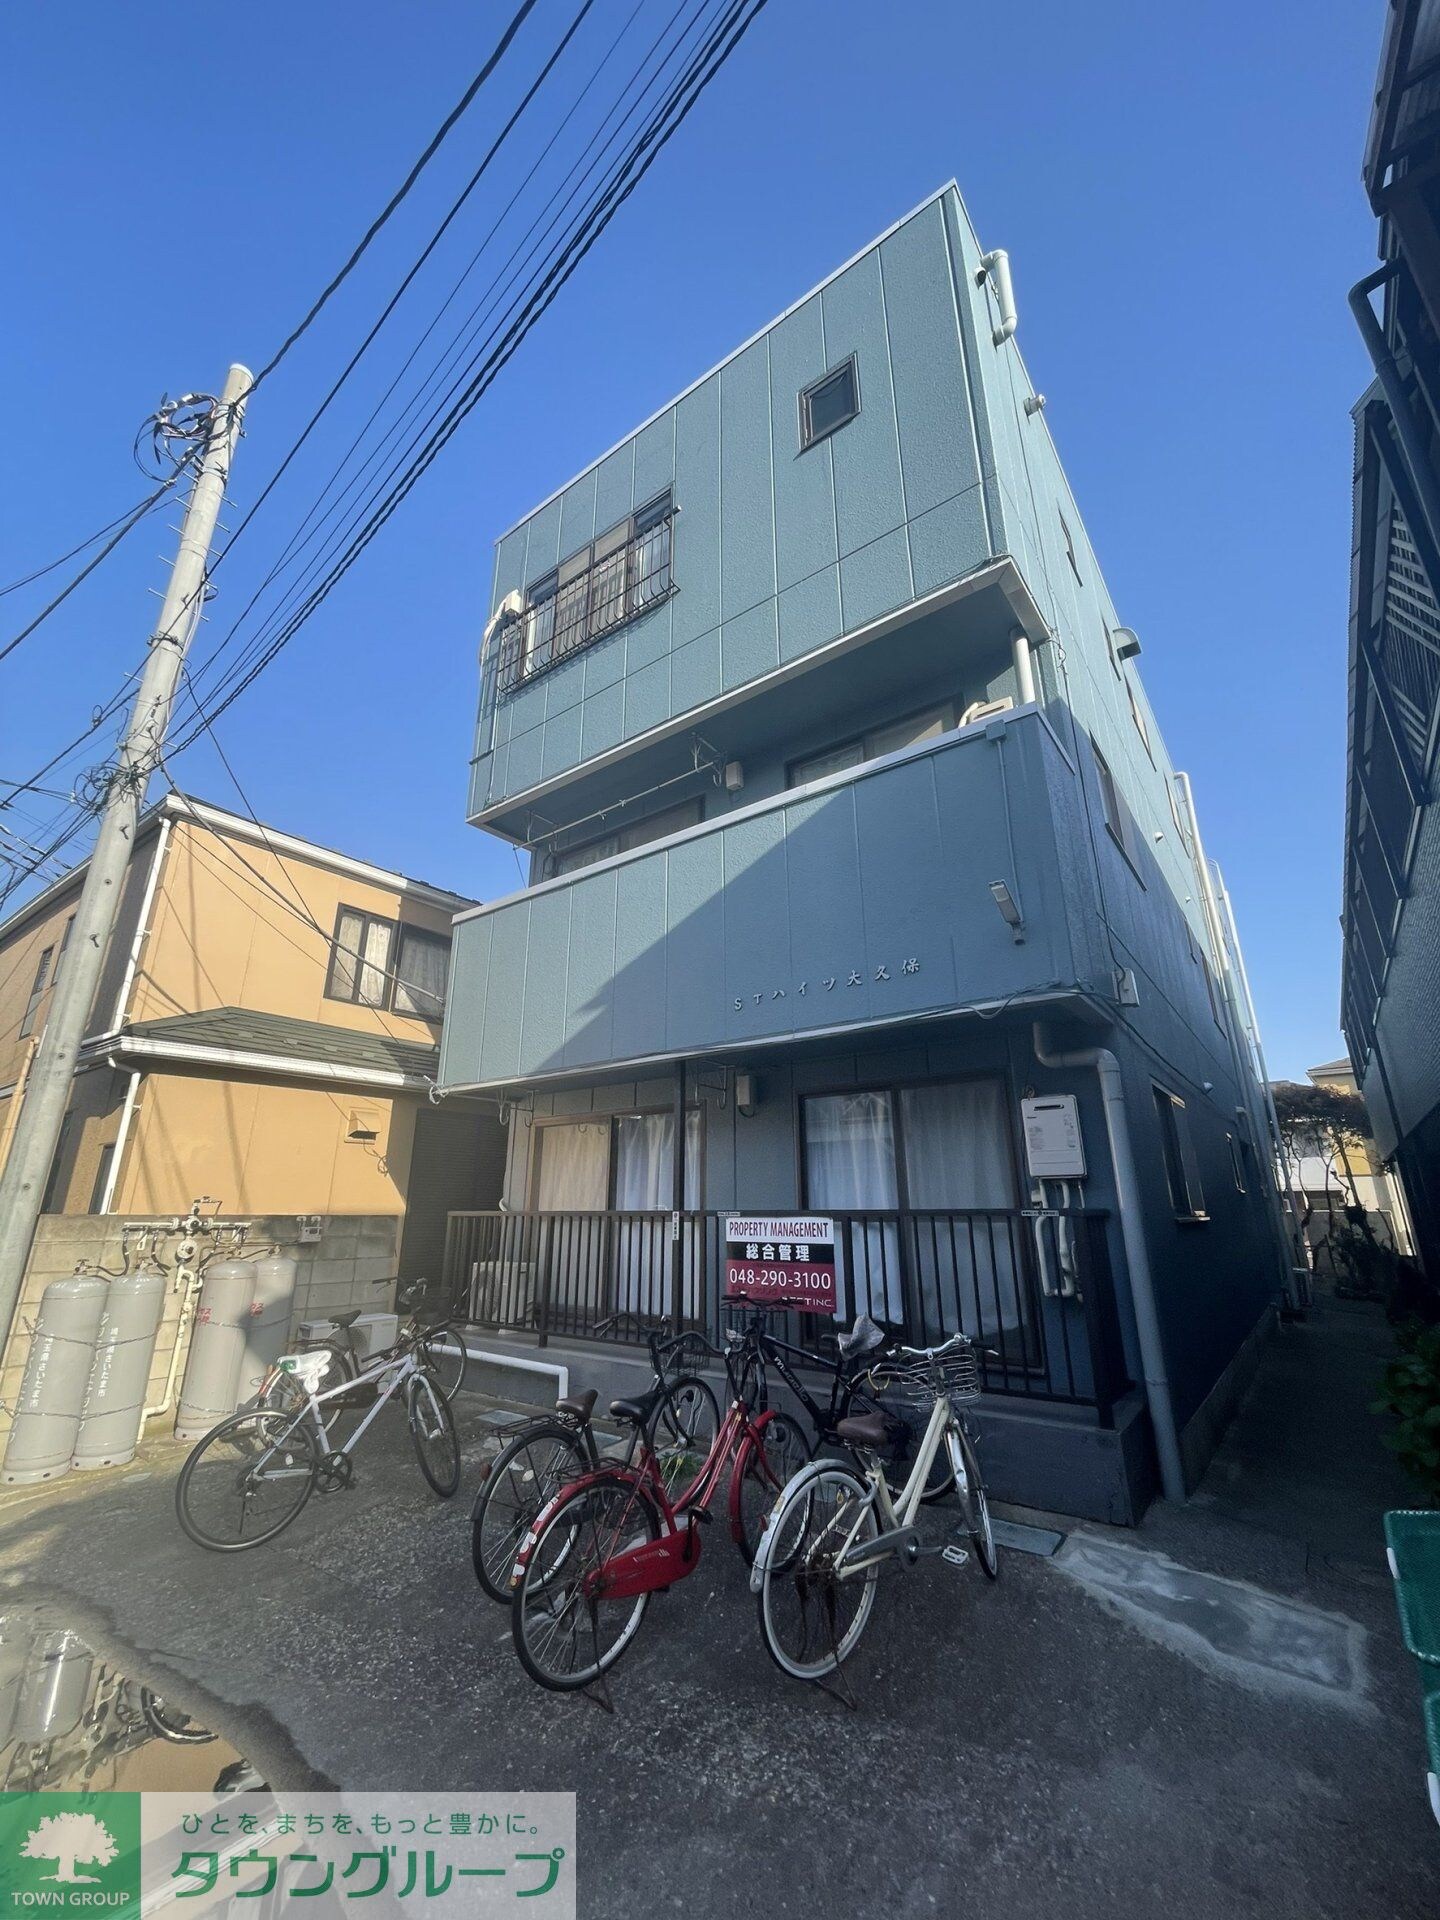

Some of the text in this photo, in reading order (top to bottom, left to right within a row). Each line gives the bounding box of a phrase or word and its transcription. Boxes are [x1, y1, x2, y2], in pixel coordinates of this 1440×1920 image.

[729, 1221, 829, 1238] PROPERTY MANAGEMENT
[745, 1243, 810, 1262] 総合管理
[729, 1268, 831, 1290] 048-290-3100
